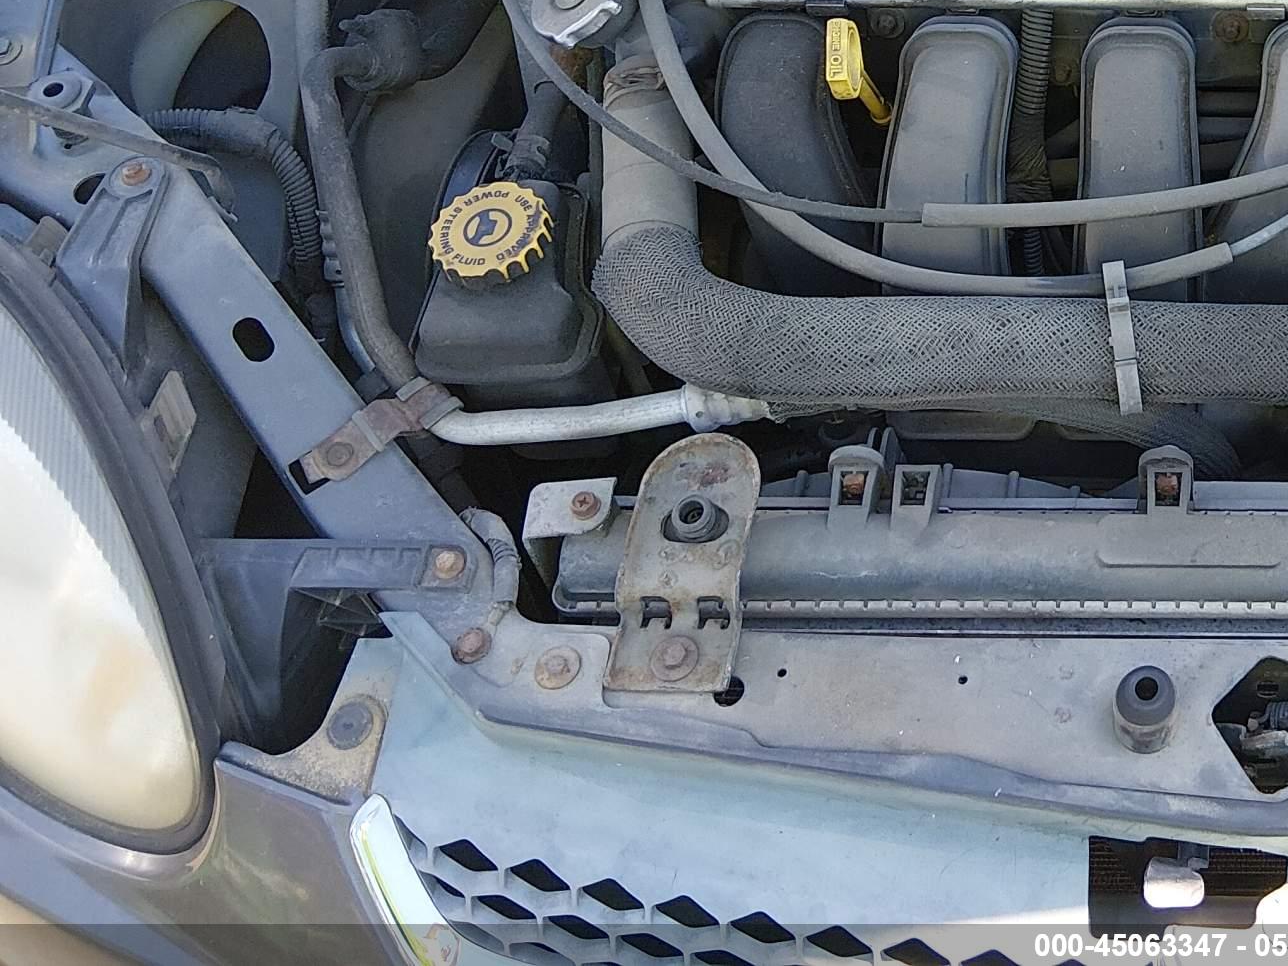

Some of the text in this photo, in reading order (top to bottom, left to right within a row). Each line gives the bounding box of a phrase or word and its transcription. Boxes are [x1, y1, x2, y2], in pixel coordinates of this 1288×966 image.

[830, 55, 843, 78] OIL
[440, 190, 510, 266] POWER STEERING FLUID
